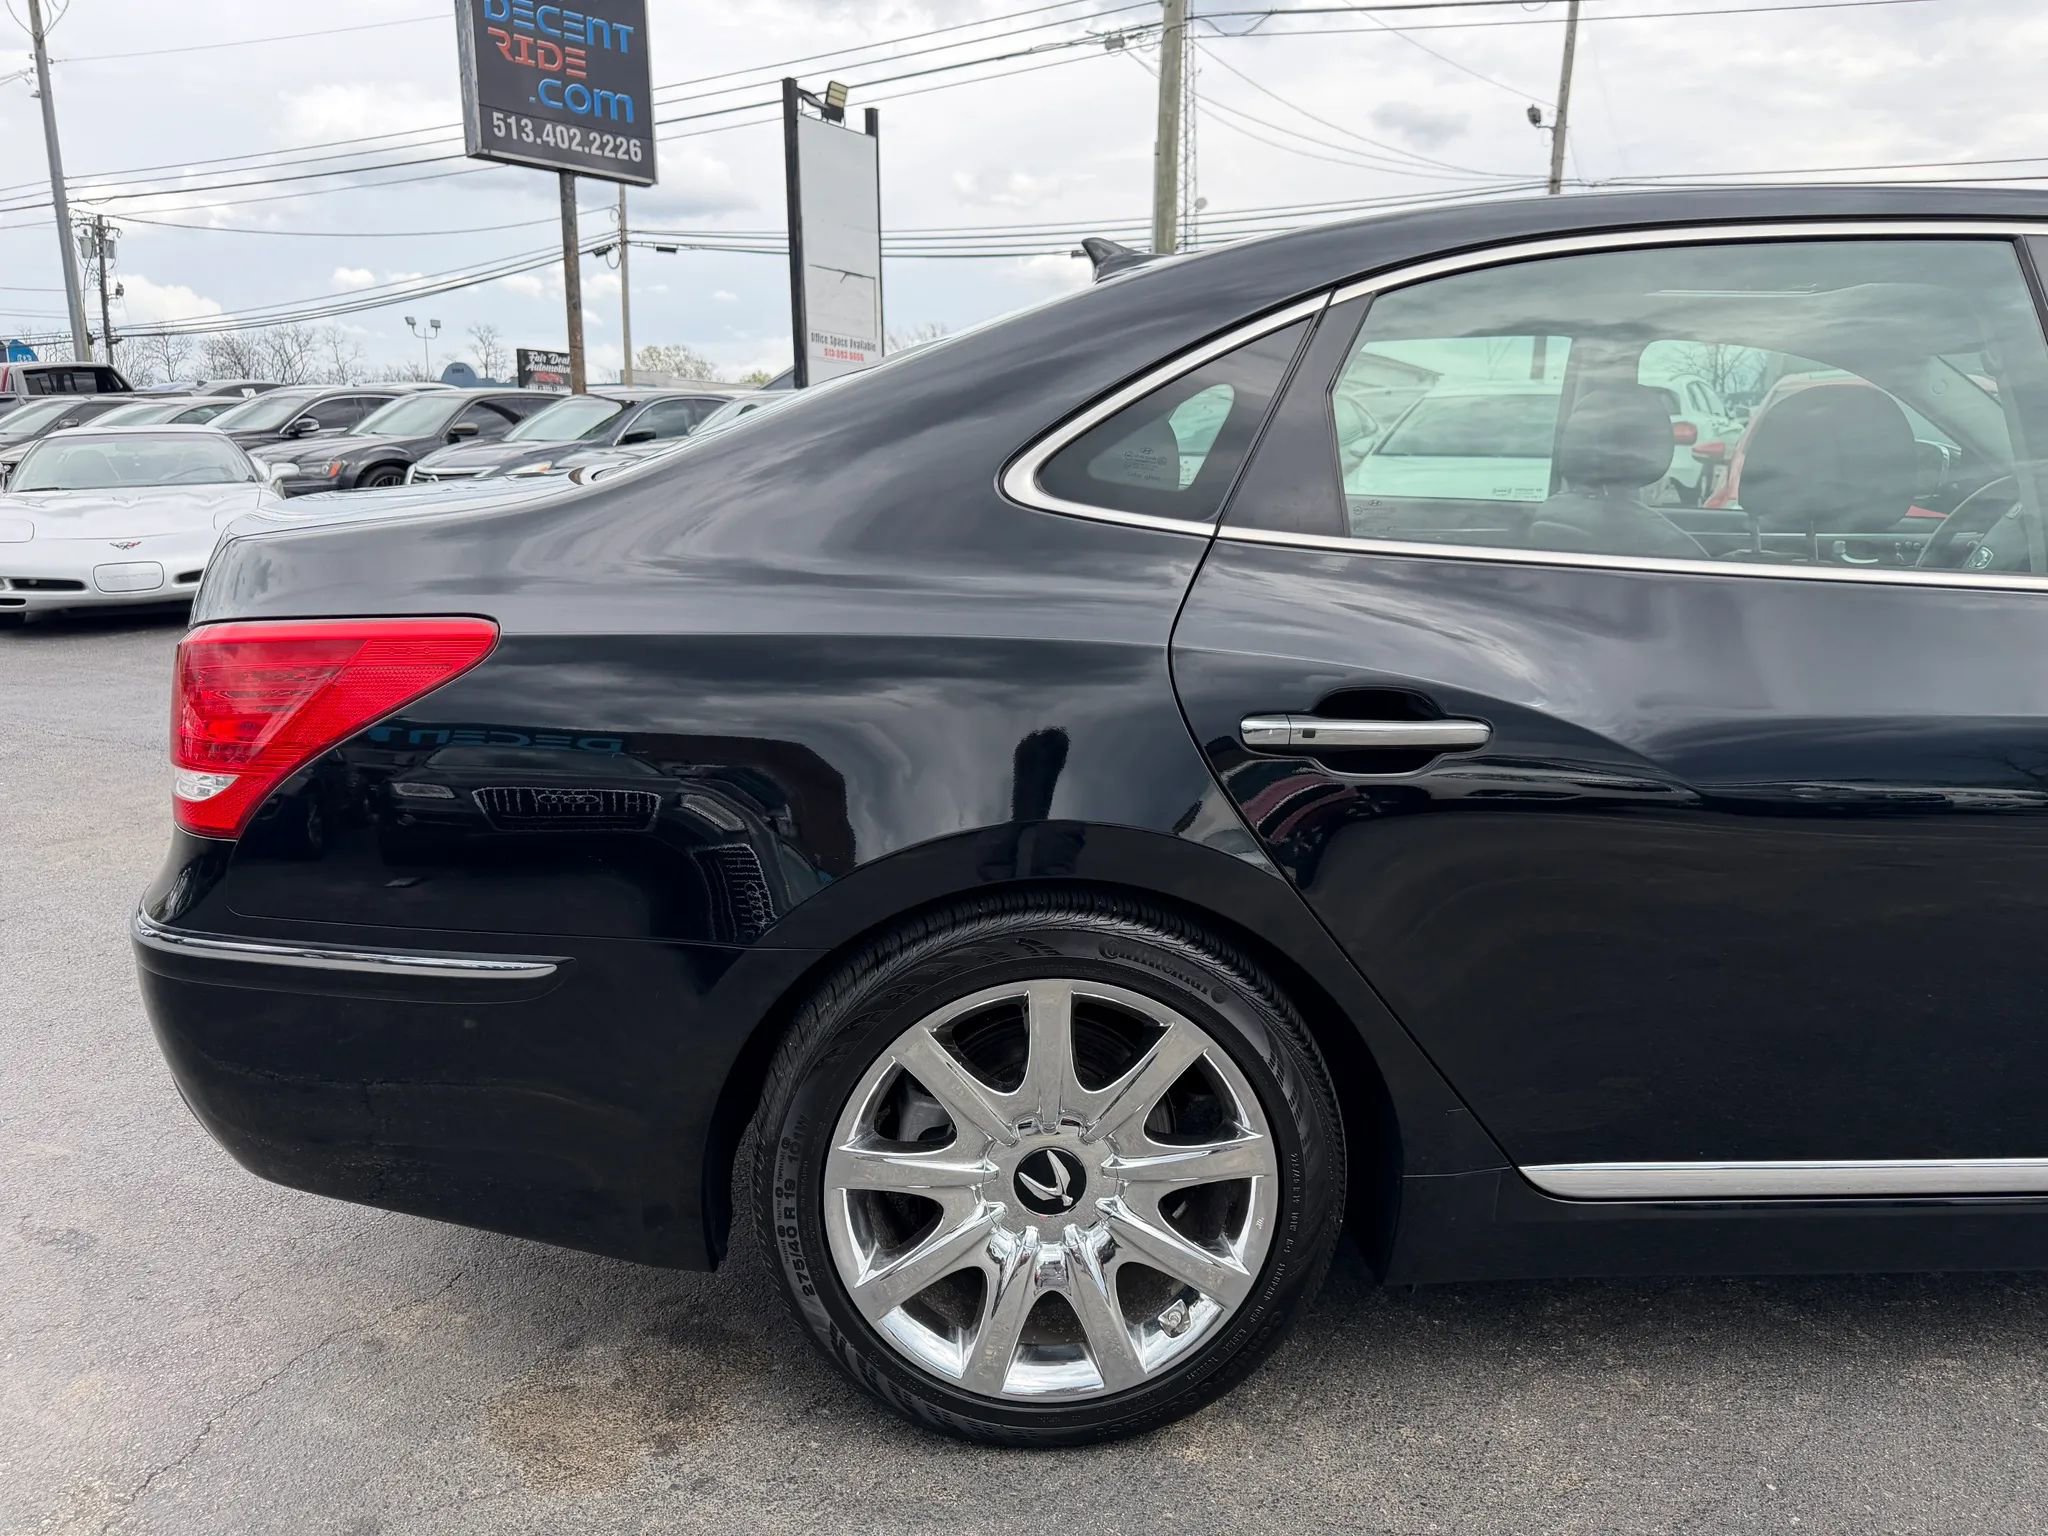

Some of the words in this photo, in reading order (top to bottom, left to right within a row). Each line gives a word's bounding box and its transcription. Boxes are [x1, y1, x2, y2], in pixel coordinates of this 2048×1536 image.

[484, 0, 634, 53] DECENT
[487, 27, 587, 79] RIDE
[492, 111, 642, 162] 513.402.2226
[527, 351, 547, 364] Fair
[548, 353, 570, 365] Deal
[783, 1178, 796, 1200] 19
[783, 1206, 796, 1220] R
[786, 1225, 816, 1297] 275/40
